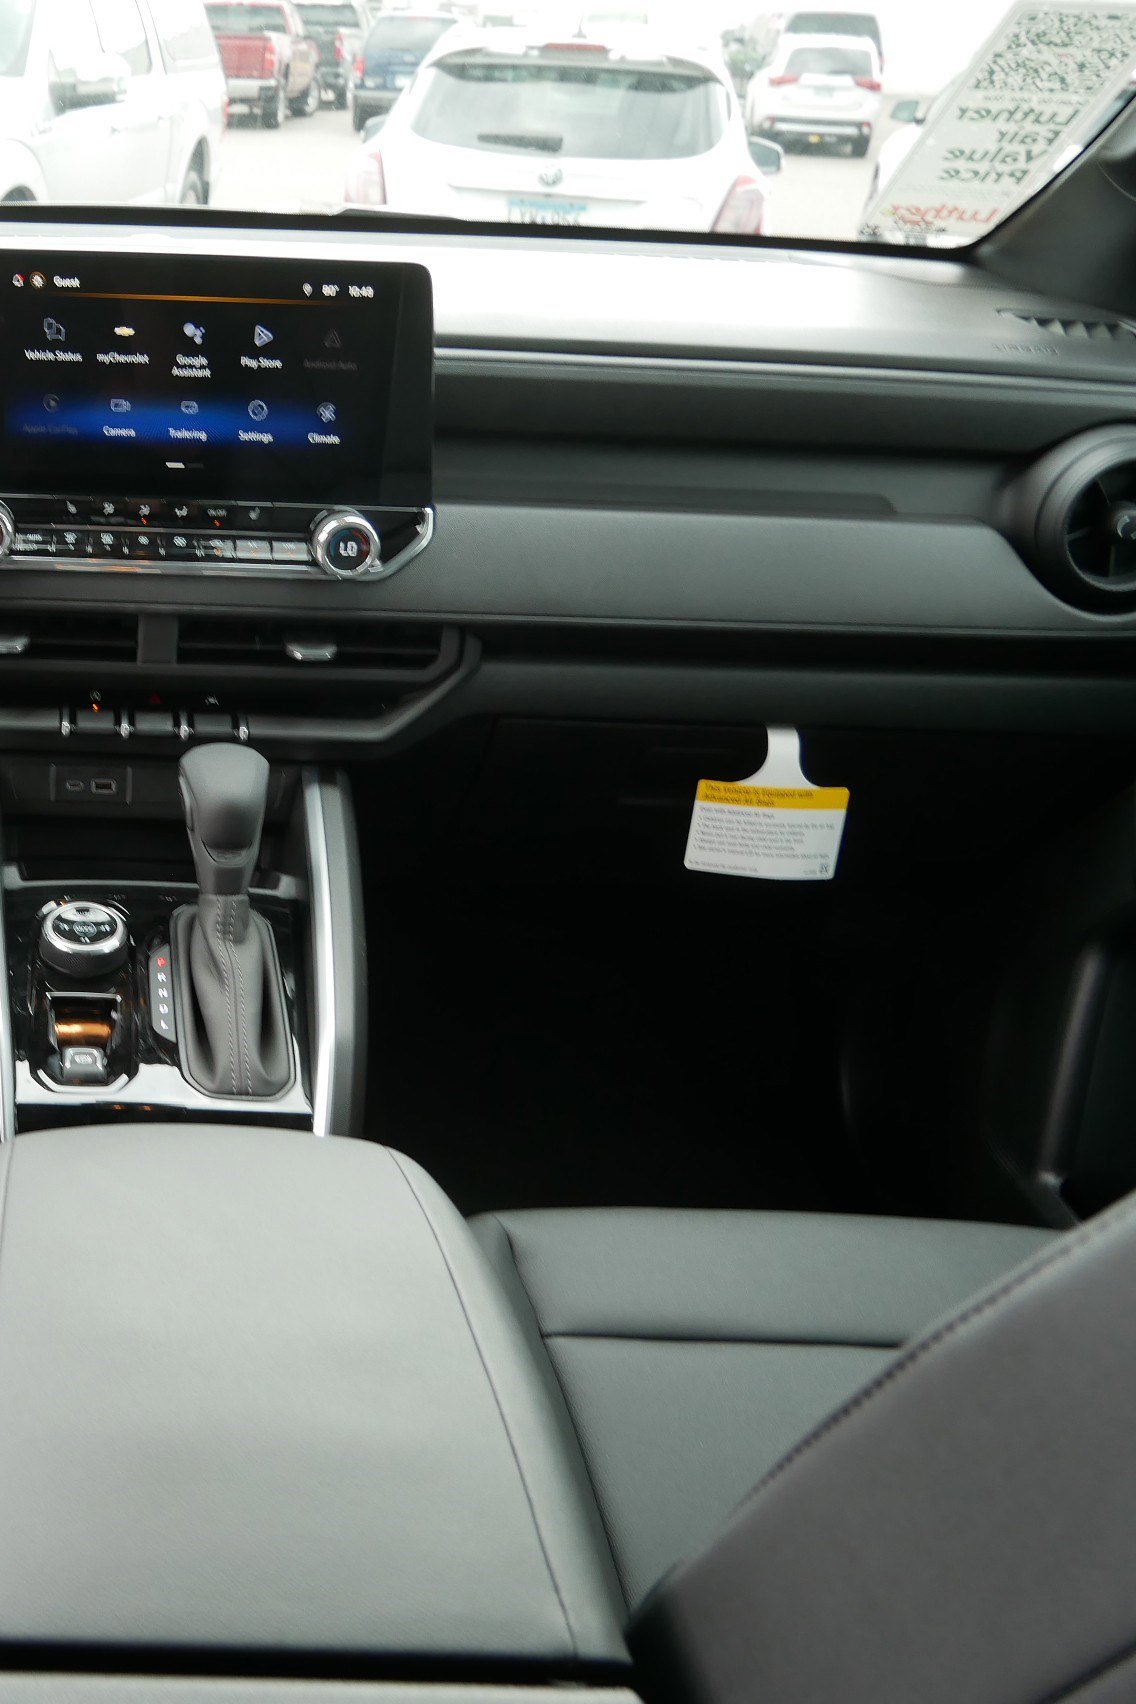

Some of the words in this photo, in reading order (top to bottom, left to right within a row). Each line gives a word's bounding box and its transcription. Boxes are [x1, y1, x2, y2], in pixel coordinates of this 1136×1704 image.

[53, 275, 80, 288] Guest
[24, 349, 55, 362] Vehicle
[55, 350, 83, 362] Status
[96, 352, 149, 365] myChevrolet
[176, 353, 208, 368] Google
[240, 355, 258, 370] Play
[259, 356, 282, 369] Store
[171, 365, 211, 378] Assistant
[102, 425, 136, 438] Camera
[168, 427, 208, 442] Trailering
[238, 430, 274, 444] Settings
[307, 432, 341, 445] Climate
